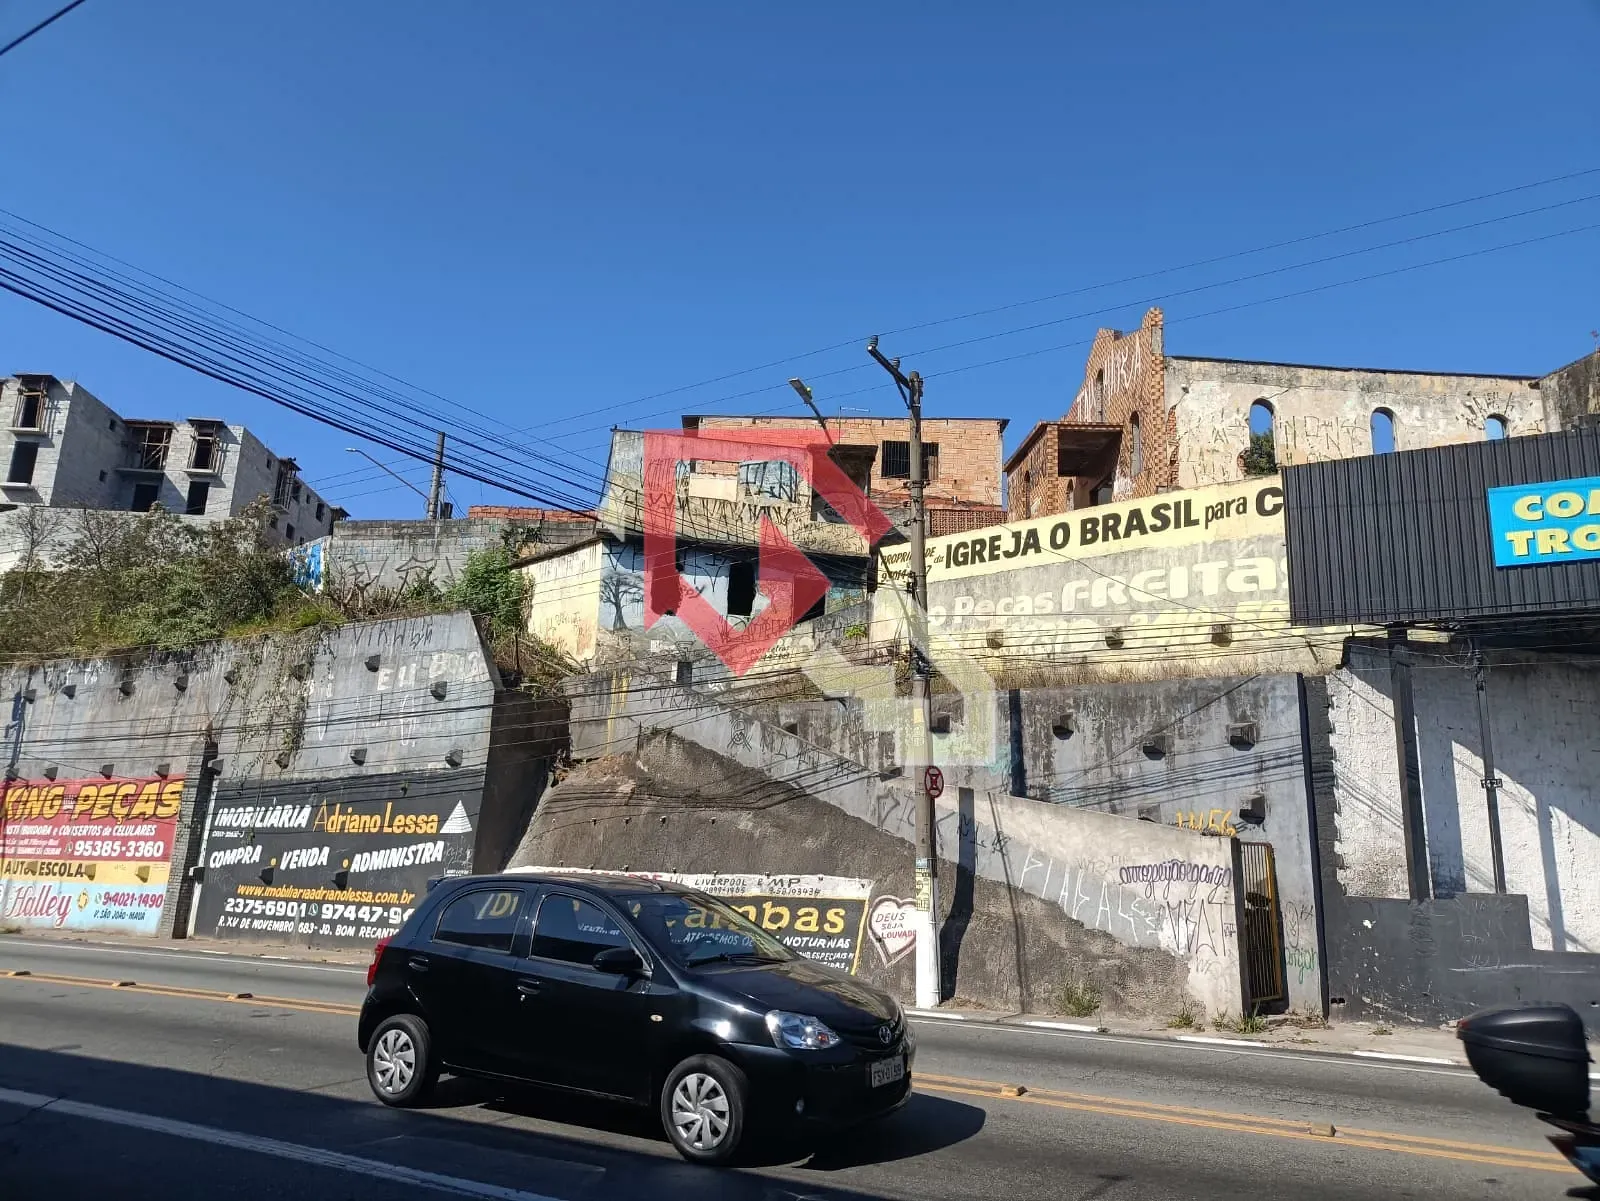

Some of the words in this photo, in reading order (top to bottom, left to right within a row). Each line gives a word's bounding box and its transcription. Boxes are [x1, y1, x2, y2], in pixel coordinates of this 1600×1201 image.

[945, 528, 1042, 569] IGREJA
[1050, 522, 1071, 550] O
[1080, 499, 1200, 546] BRASIL
[1205, 496, 1248, 530] para
[4, 785, 66, 821] KING
[72, 780, 185, 824] PEÇAS
[313, 797, 381, 833] Adriano
[383, 801, 439, 834] Lessa
[112, 825, 157, 837] CELULARES
[209, 845, 263, 868] COMPRA
[280, 846, 330, 870] VENDA
[350, 840, 445, 872] ADMINISTRA
[38, 862, 84, 877] ESCOLA
[694, 878, 748, 887] LIVERPOOL
[5, 884, 72, 928] Halley
[876, 912, 906, 923] DEUS
[881, 922, 904, 930] SEJA
[240, 918, 251, 929] DE
[252, 919, 294, 933] NOVEMBRO
[335, 926, 355, 937] BOM
[783, 935, 851, 950] NOTURNAS
